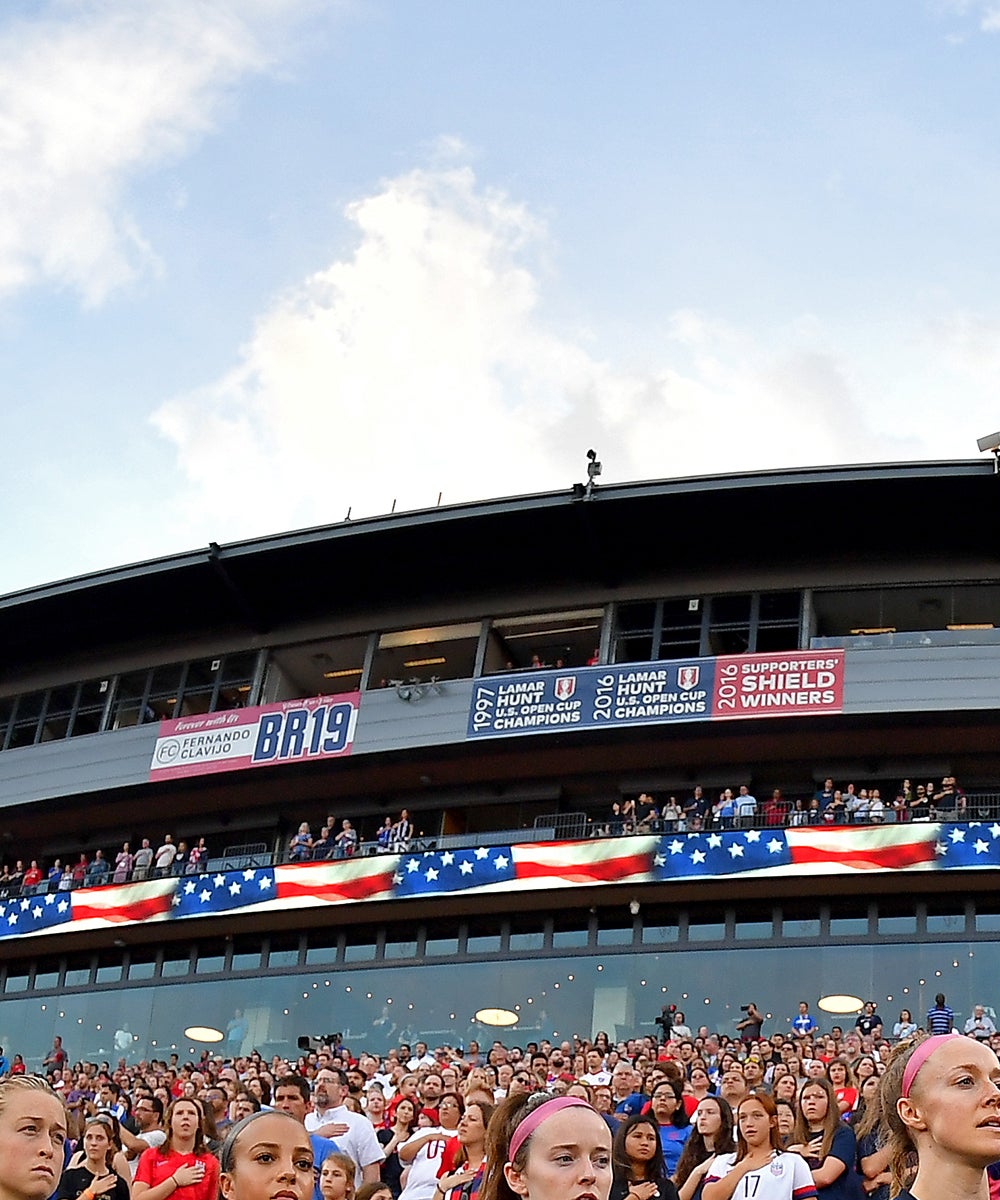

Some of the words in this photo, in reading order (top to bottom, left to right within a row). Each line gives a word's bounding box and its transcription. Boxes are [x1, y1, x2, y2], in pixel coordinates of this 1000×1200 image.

[741, 659, 839, 674] SUPPORTERS'
[618, 670, 667, 684] LAMAR
[741, 671, 836, 692] SHIELD
[499, 681, 545, 695] LAMAR
[617, 681, 666, 696] HUNT
[717, 664, 739, 710] 2016
[497, 692, 543, 707] HUNT
[593, 675, 615, 720] 2016
[616, 695, 641, 706] U.S.
[643, 692, 678, 704] OPEN
[679, 690, 706, 701] CUP
[740, 690, 835, 708] WINNERS
[474, 688, 495, 732] 1997
[495, 707, 518, 718] U.S.
[521, 703, 554, 715] OPEN
[556, 700, 581, 712] CUP
[615, 701, 706, 719] CHAMPIONS
[494, 711, 580, 730] CHAMPIONS
[183, 730, 250, 748] FERNANDO
[252, 703, 354, 763] BR19
[159, 745, 177, 759] FC
[181, 743, 232, 760] CLAVIJO
[744, 1175, 761, 1198] 17
